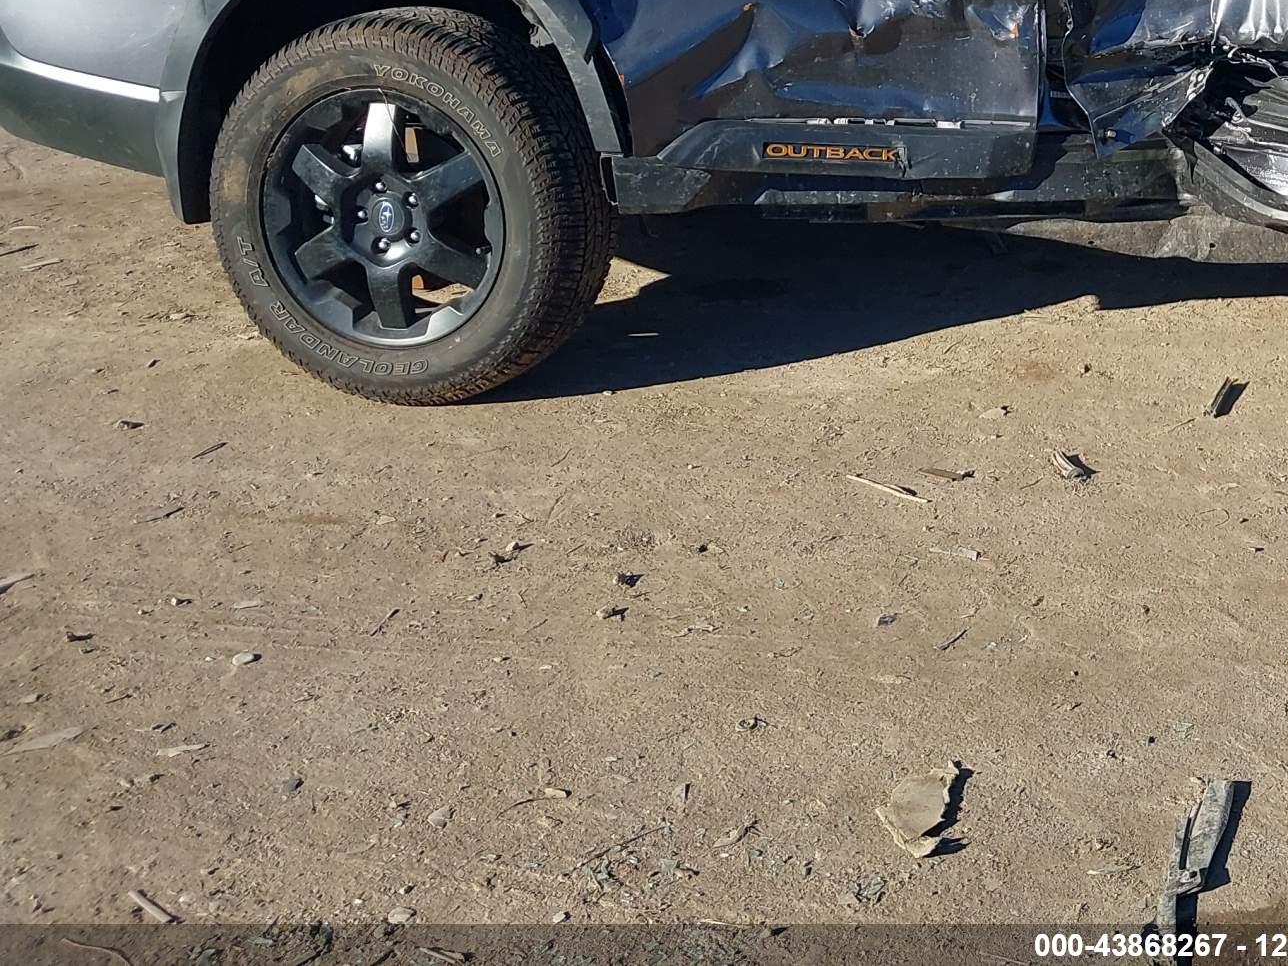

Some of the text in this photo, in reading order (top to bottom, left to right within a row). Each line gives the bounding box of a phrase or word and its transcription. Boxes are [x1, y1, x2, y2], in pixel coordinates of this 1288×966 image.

[374, 64, 501, 157] YOKOHAMA
[766, 143, 897, 162] OUTBACK
[237, 236, 429, 376] GEOLANDAR A/T
